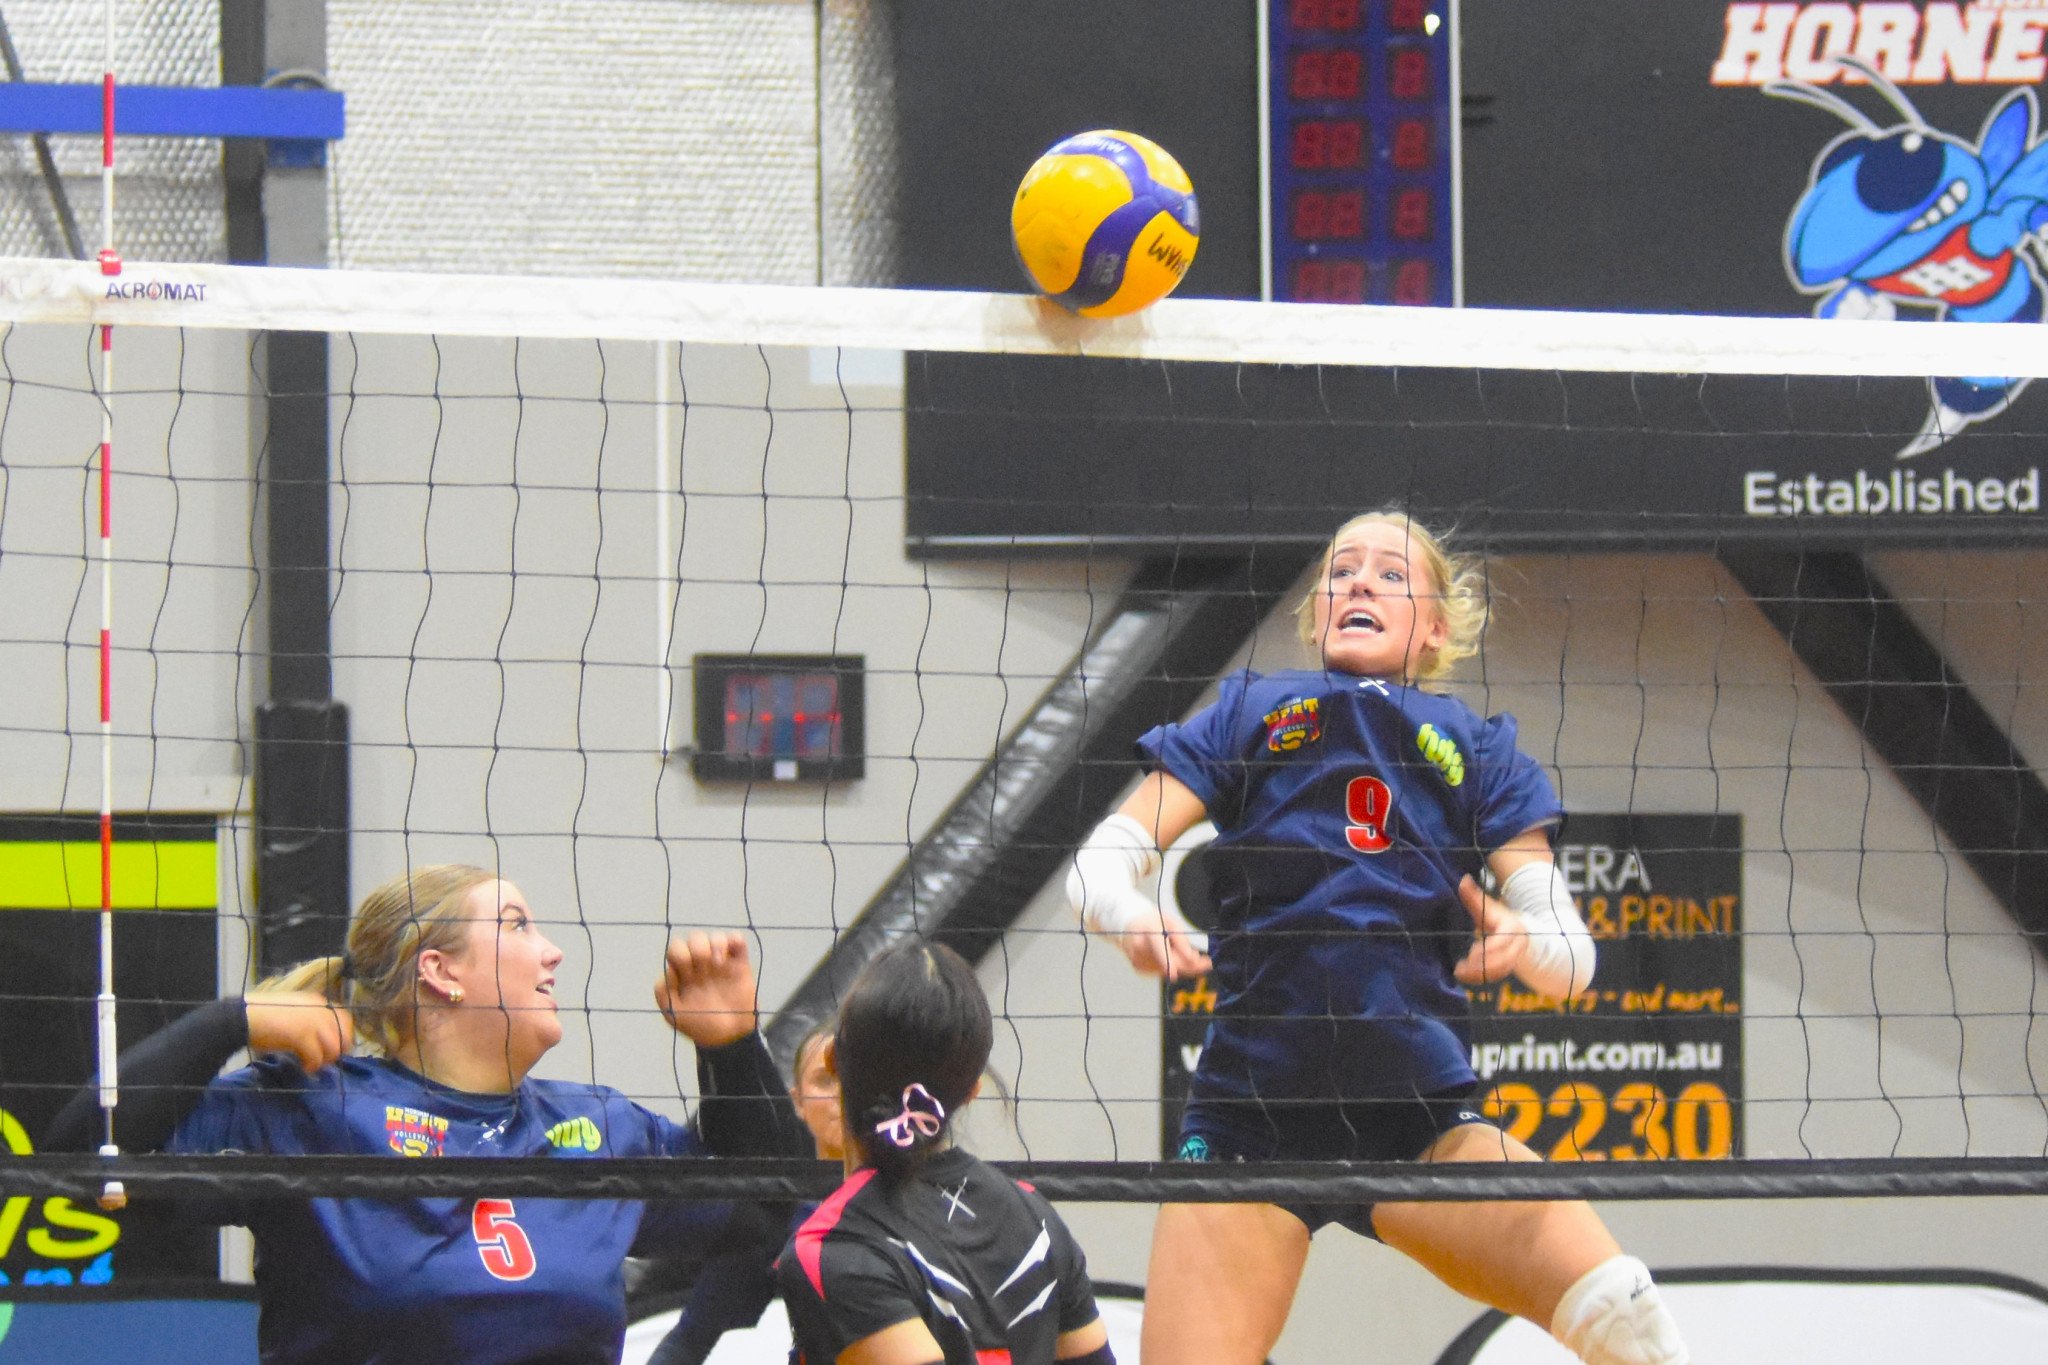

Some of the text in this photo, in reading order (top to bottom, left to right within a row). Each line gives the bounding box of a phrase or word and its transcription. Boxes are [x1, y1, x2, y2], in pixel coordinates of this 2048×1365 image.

[106, 281, 207, 301] ACROMAT
[1743, 466, 2041, 515] Established
[1345, 774, 1394, 854] 9
[1560, 844, 1652, 893] ERA
[1573, 894, 1739, 941] &PRINT
[1471, 1033, 1723, 1080] print.com.au
[386, 1106, 449, 1143] HEAT
[1482, 1081, 1733, 1161] 2230
[472, 1198, 537, 1282] 5
